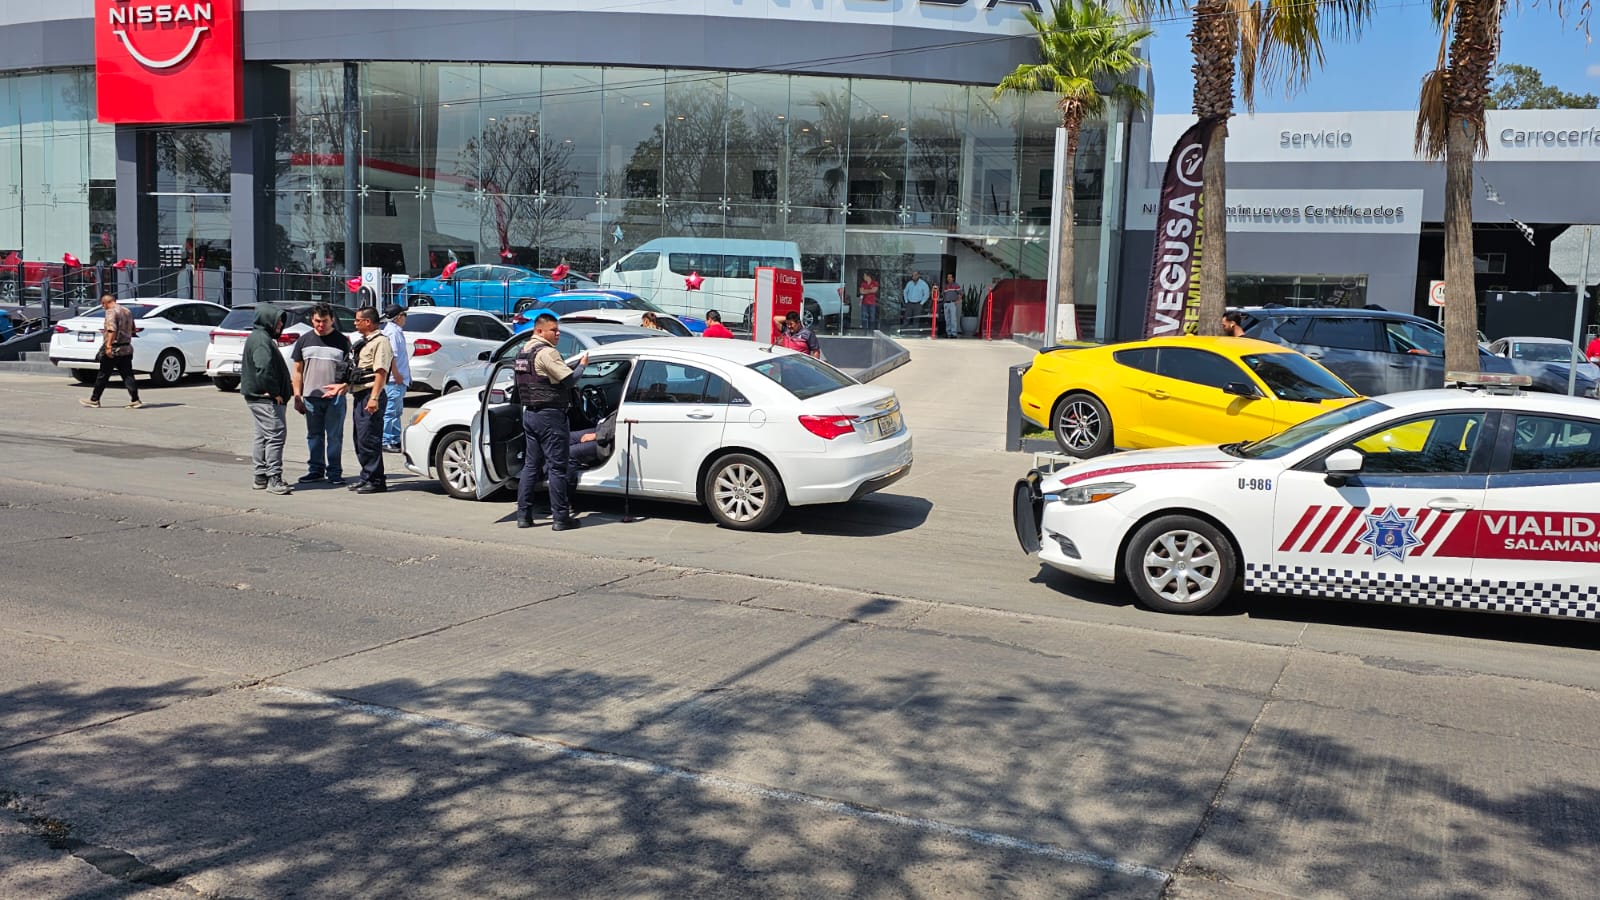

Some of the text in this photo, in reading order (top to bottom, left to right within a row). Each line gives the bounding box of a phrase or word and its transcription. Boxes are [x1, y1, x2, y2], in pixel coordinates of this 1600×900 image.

[109, 3, 212, 24] NISSAN
[1280, 129, 1352, 146] Servicio
[1226, 204, 1404, 217] minuevos Certificados
[1153, 192, 1196, 335] VEGUSA
[1238, 478, 1272, 490] U-986
[1483, 515, 1600, 537] VIALID
[1504, 538, 1600, 552] SALAMAN
